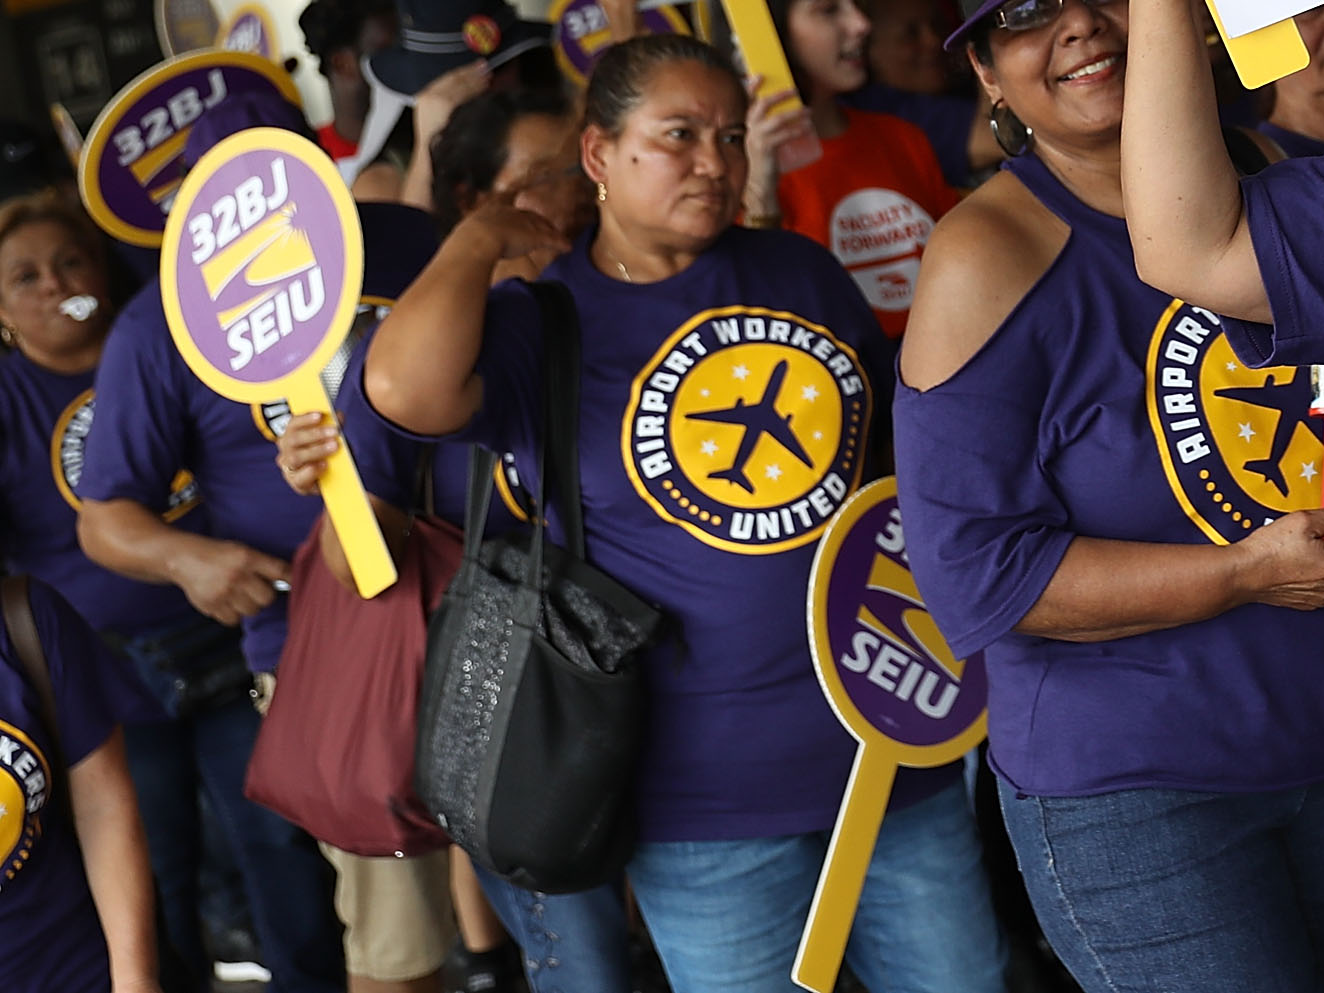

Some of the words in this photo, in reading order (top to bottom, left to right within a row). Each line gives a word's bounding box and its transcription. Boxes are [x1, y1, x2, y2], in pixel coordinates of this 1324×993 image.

[112, 67, 228, 167] 32BJ
[187, 157, 290, 265] 32BJ
[226, 265, 326, 372] SEIU
[636, 331, 708, 479] AIRPORT
[711, 317, 865, 397] WORKERS
[729, 472, 848, 541] UNITED
[840, 630, 960, 720] SEIU
